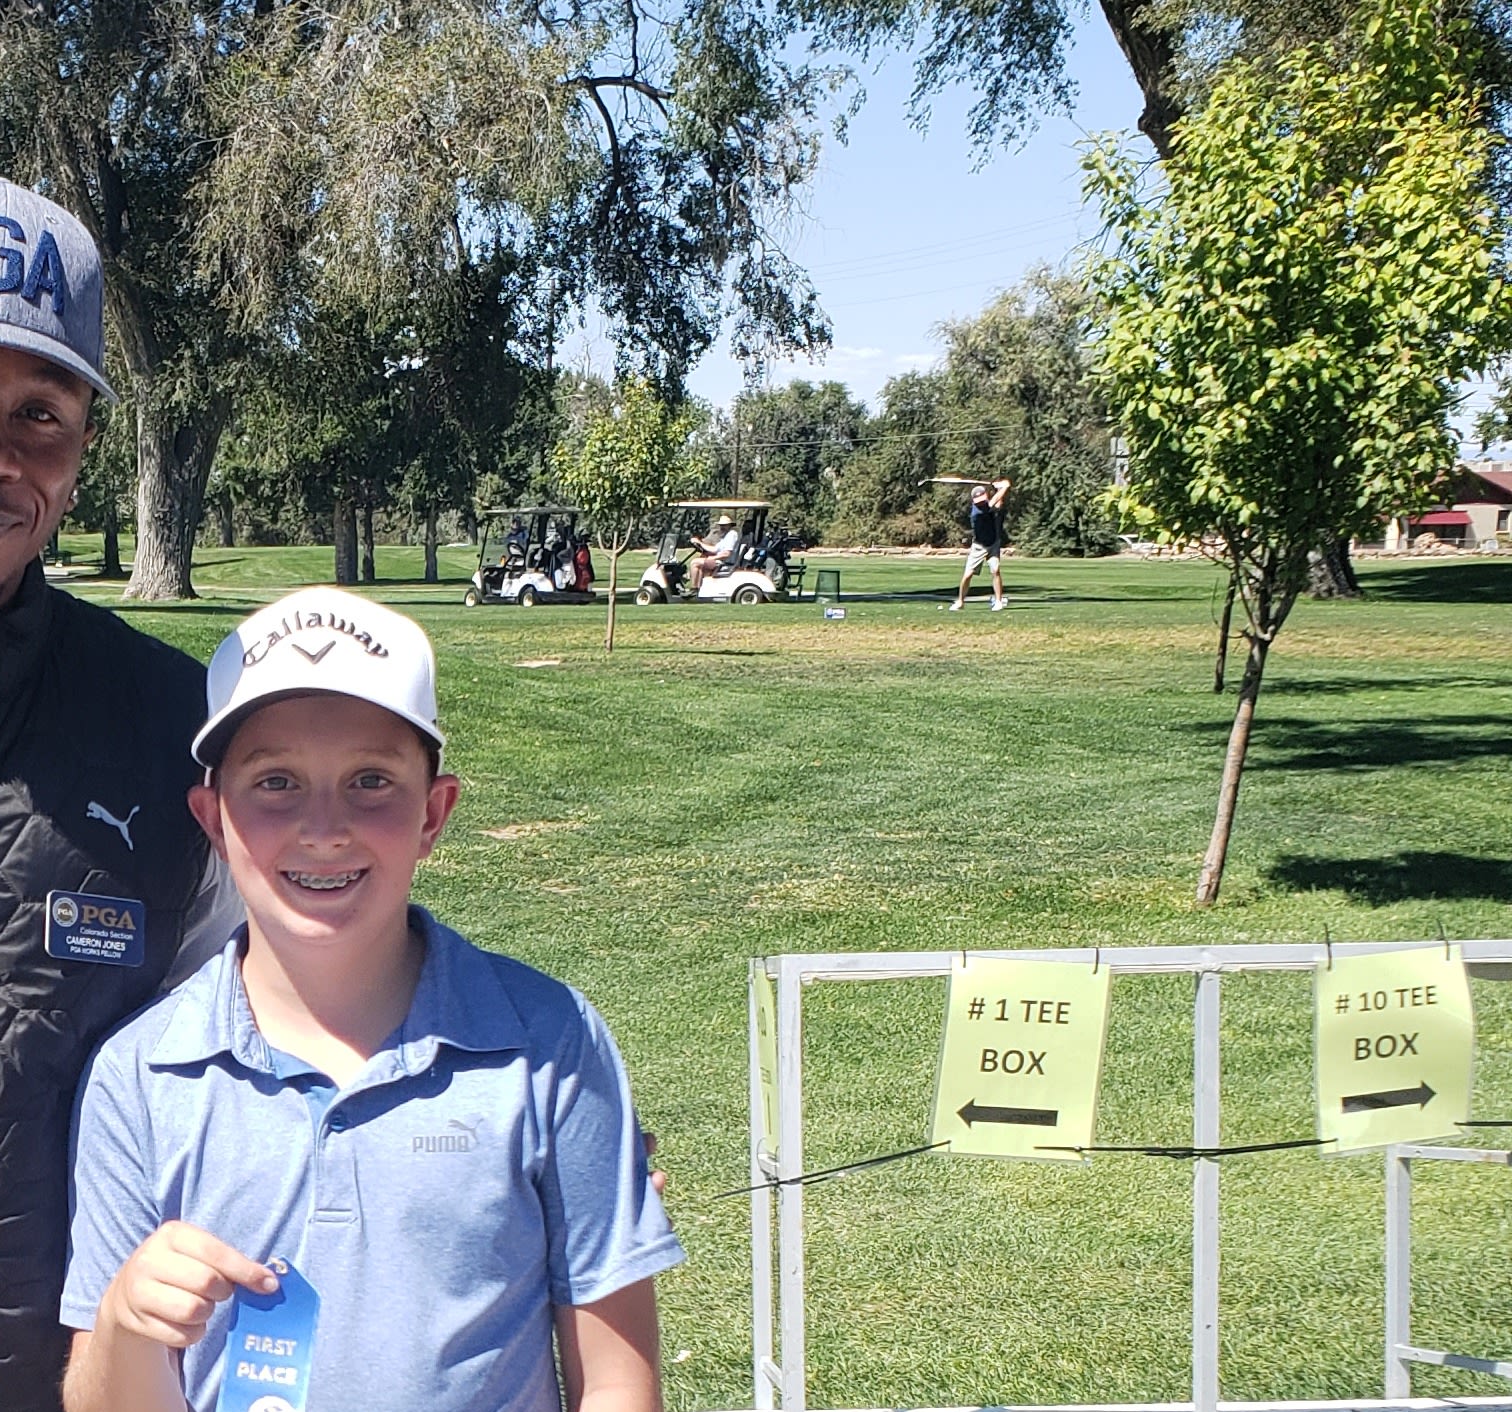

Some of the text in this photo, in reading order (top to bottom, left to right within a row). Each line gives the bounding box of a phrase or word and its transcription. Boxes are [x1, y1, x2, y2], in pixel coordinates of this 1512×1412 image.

[243, 610, 389, 668] Callaway
[81, 905, 136, 930] PGA
[66, 936, 125, 951] CAMERON JONES
[80, 927, 133, 940] Colorado Section
[968, 997, 1071, 1024] # 1 TEE
[1335, 985, 1438, 1015] # 10 TEE
[1354, 1033, 1419, 1061] BOX
[980, 1049, 1047, 1075] BOX
[412, 1135, 470, 1153] PUMA
[244, 1334, 297, 1356] FIRST
[237, 1362, 298, 1385] PLACE
